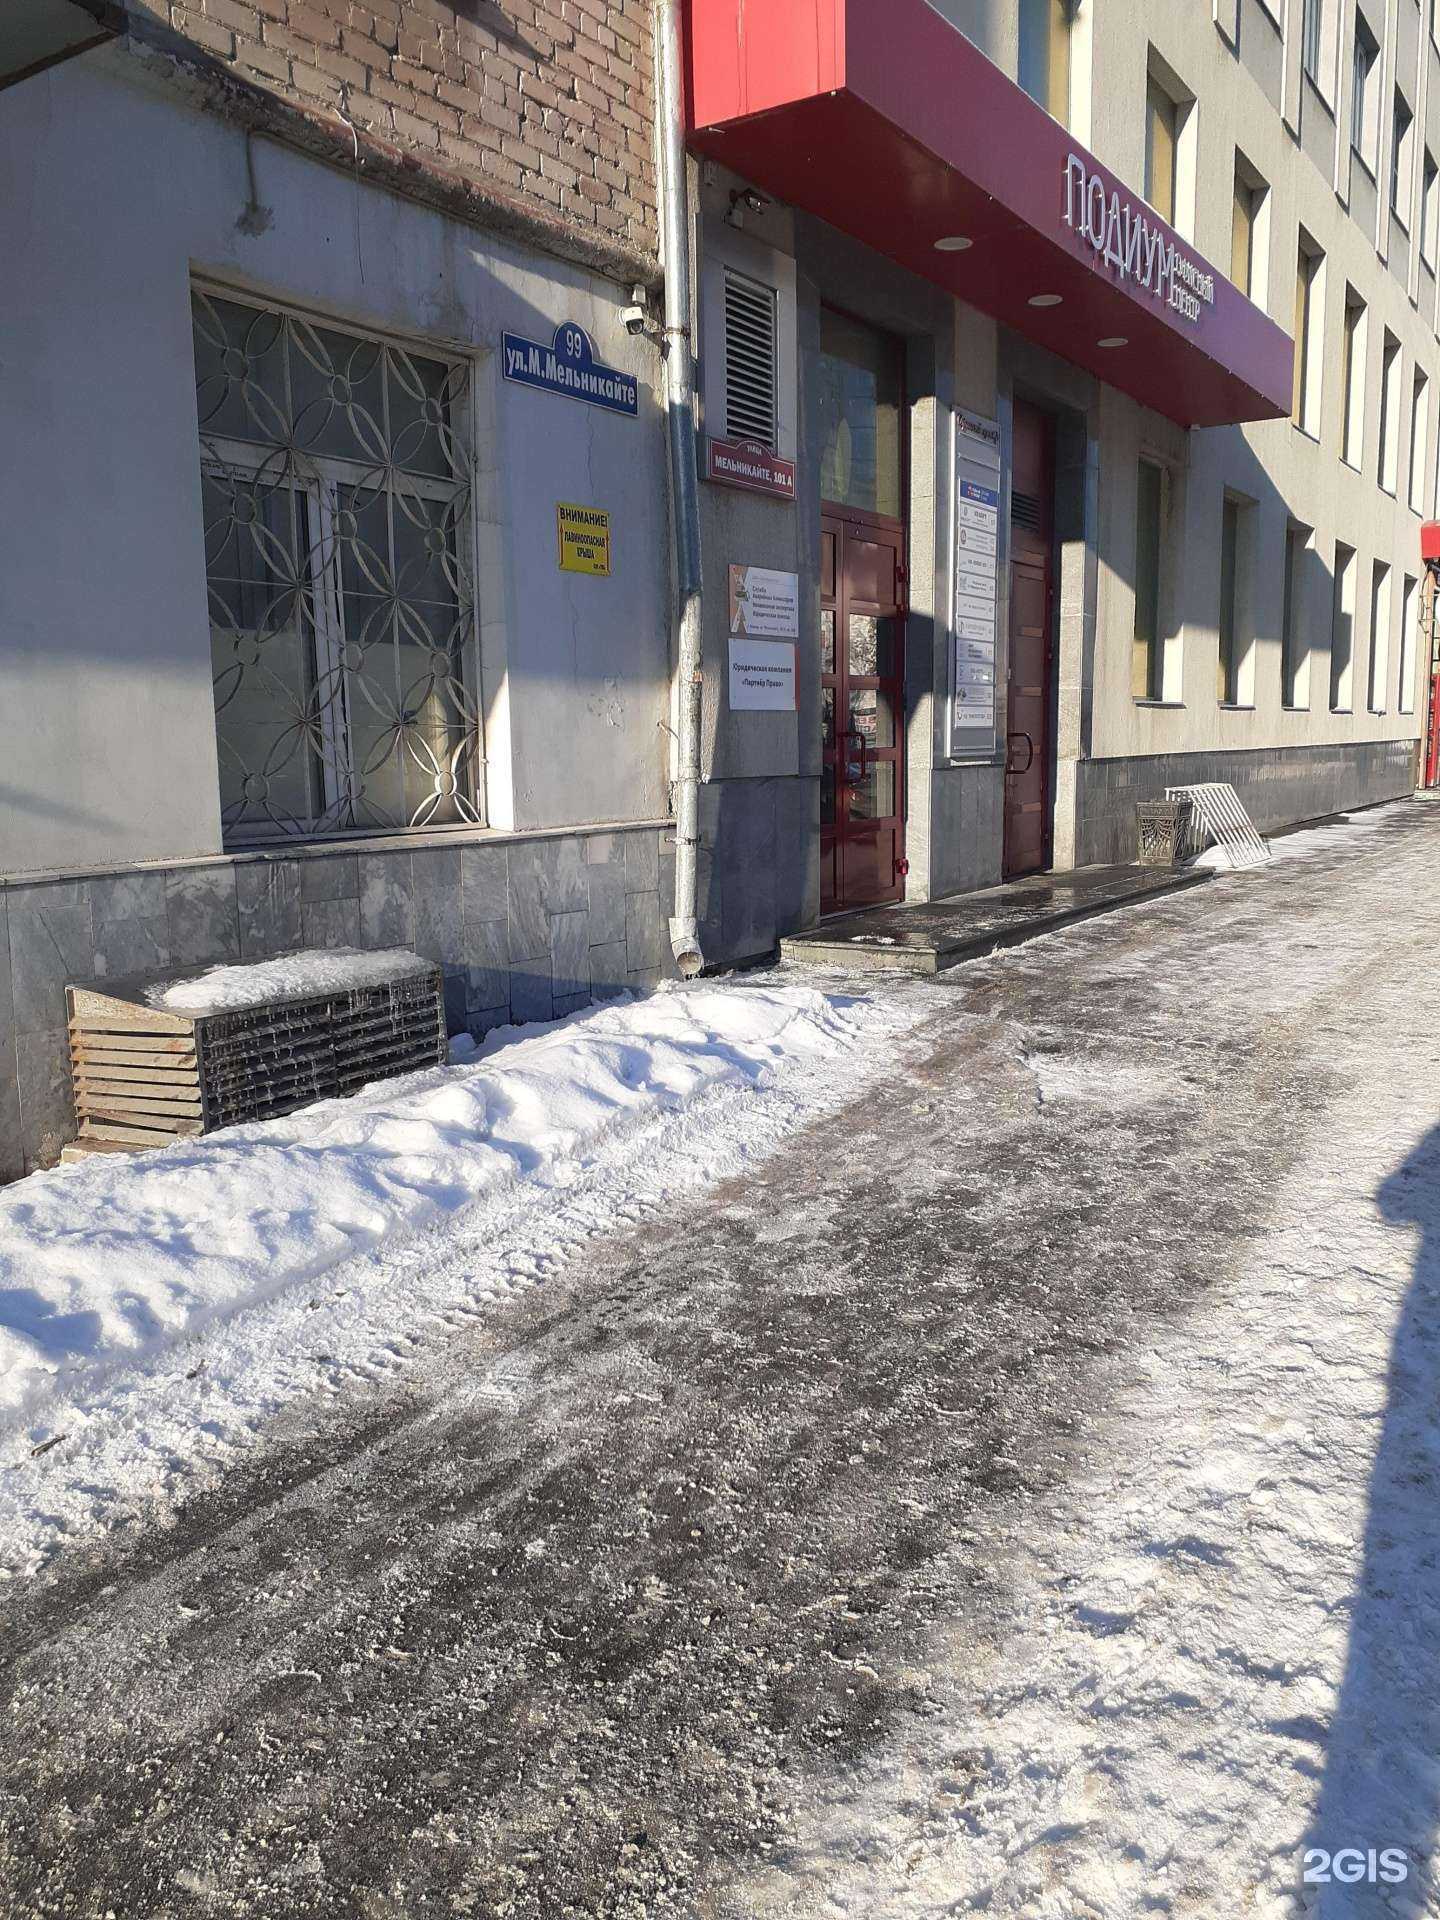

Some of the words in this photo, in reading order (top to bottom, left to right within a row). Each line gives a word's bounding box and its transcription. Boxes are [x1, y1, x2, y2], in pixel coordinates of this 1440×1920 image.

[1068, 153, 1175, 306] ПОДИУМ
[566, 330, 582, 359] 99
[715, 454, 773, 482] МЕЛЬНИКАЙТЕ,
[560, 507, 608, 528] ВНИМАНИЕ!
